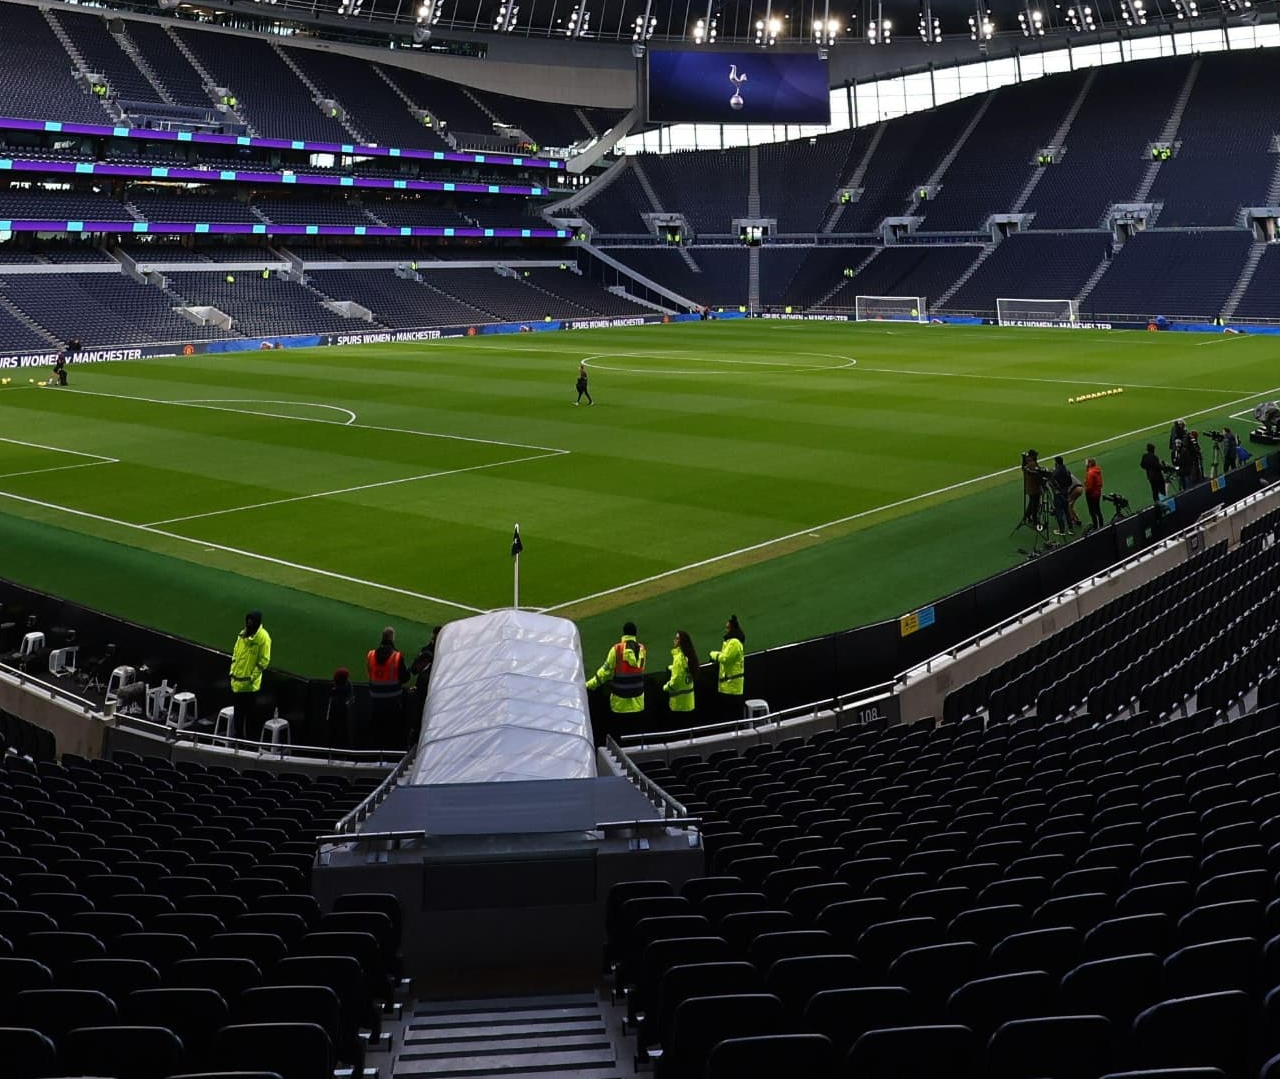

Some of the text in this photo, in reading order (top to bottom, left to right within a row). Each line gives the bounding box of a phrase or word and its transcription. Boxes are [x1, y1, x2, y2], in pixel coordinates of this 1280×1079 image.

[337, 334, 362, 346] SPURS
[363, 332, 390, 344] WOMEN
[396, 330, 441, 342] MANCHESTER
[72, 349, 142, 364] MANCHESTER
[859, 707, 878, 725] 108
